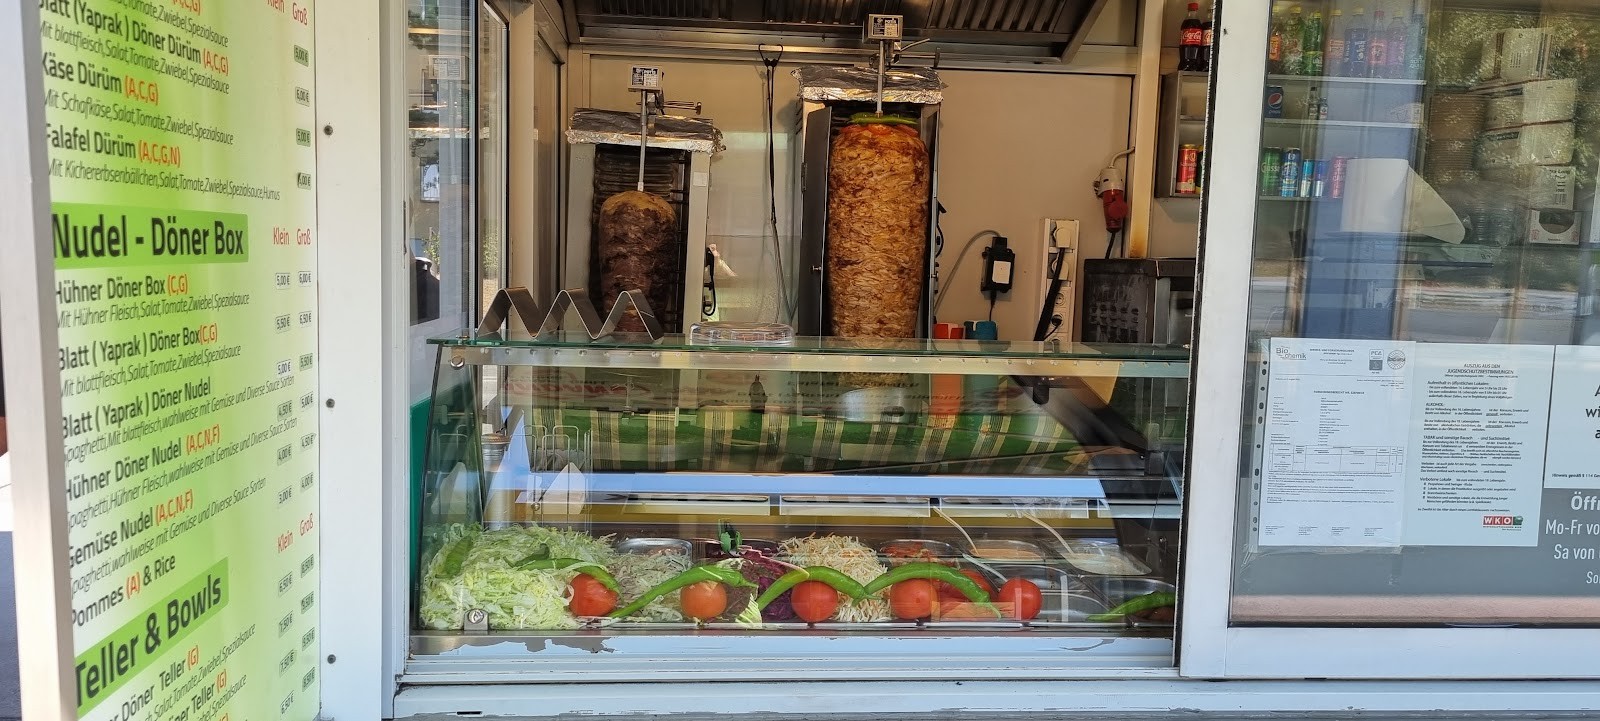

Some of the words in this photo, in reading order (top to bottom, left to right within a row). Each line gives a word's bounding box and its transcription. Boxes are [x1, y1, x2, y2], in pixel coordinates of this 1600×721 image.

[292, 2, 307, 25] Groß
[132, 20, 166, 51] Döner
[168, 34, 201, 65] Dürüm
[203, 48, 229, 76] (A,C,G)
[78, 61, 122, 93] Dürüm
[125, 75, 158, 106] (A,C,G)
[94, 131, 136, 158] Dürüm
[139, 139, 181, 168] (A,C,G,N)
[52, 213, 127, 259] Nudel
[152, 216, 210, 256] Döner
[214, 220, 244, 255] Box
[273, 227, 289, 245] Klein
[297, 228, 311, 245] Groß
[107, 276, 142, 299] Döner
[146, 275, 165, 295] Box
[168, 274, 188, 296] (C,G)
[74, 307, 108, 327] Hühner
[59, 345, 90, 371] Blatt
[100, 335, 141, 366] Yaprak
[150, 330, 181, 352] Döner
[62, 411, 93, 439] Blatt
[102, 395, 143, 429] Yaprak
[152, 388, 182, 412] Döner
[184, 376, 211, 402] Nudel
[211, 393, 235, 412] Gemüse
[115, 455, 150, 482] Döner
[152, 437, 182, 467] Nudel
[186, 424, 220, 456] (A,C,N,F)
[216, 442, 239, 462] Gemüse
[121, 507, 154, 542] Nudel
[155, 488, 194, 527] (A,C,N,F)
[169, 515, 197, 539] Gemüse
[1545, 519, 1582, 535] Mo-Fr
[1554, 544, 1569, 559] Sa
[1573, 548, 1595, 560] von
[126, 571, 141, 599] (A)
[143, 565, 152, 586] &
[154, 555, 176, 580] Rice
[74, 632, 140, 708] Teller
[145, 612, 162, 655] &
[167, 573, 222, 640] Bowls
[122, 685, 155, 721] Döner
[159, 659, 186, 691] Teller
[187, 645, 199, 671] (G)
[191, 683, 215, 714] Teller
[217, 668, 227, 694] (G)
